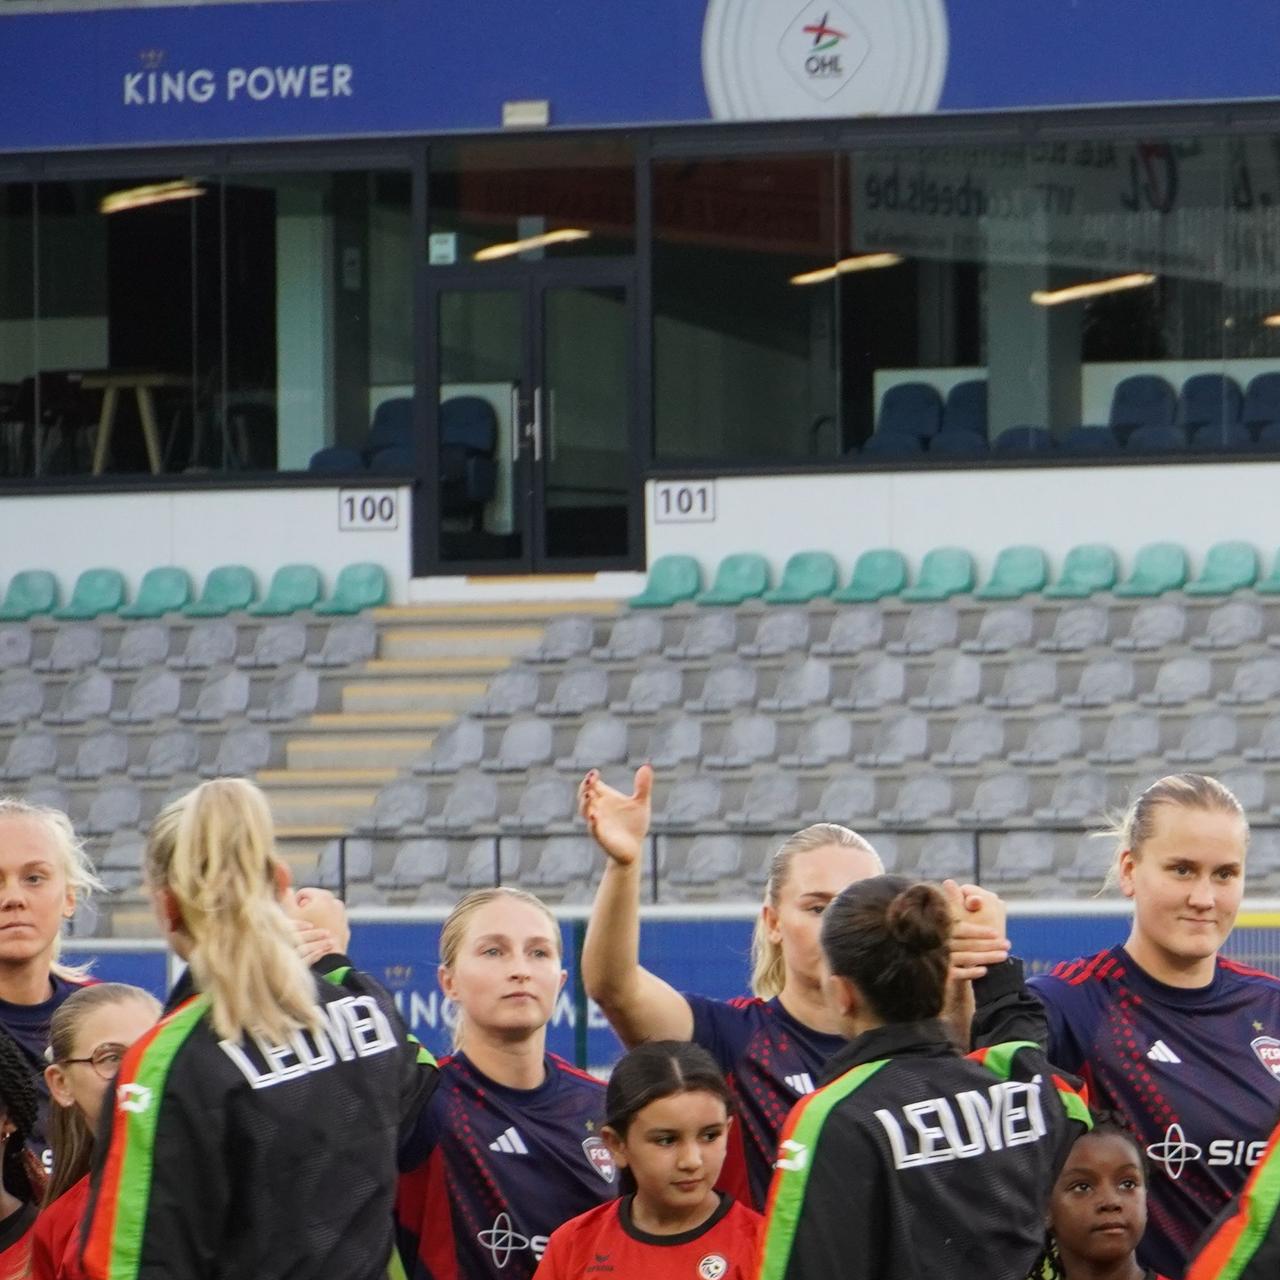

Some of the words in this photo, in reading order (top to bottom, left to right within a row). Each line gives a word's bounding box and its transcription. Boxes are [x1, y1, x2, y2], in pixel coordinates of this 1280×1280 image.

[123, 69, 216, 105] KING
[226, 63, 353, 101] POWER
[343, 494, 394, 524] 100
[659, 489, 710, 515] 101
[1207, 1139, 1270, 1166] SIG
